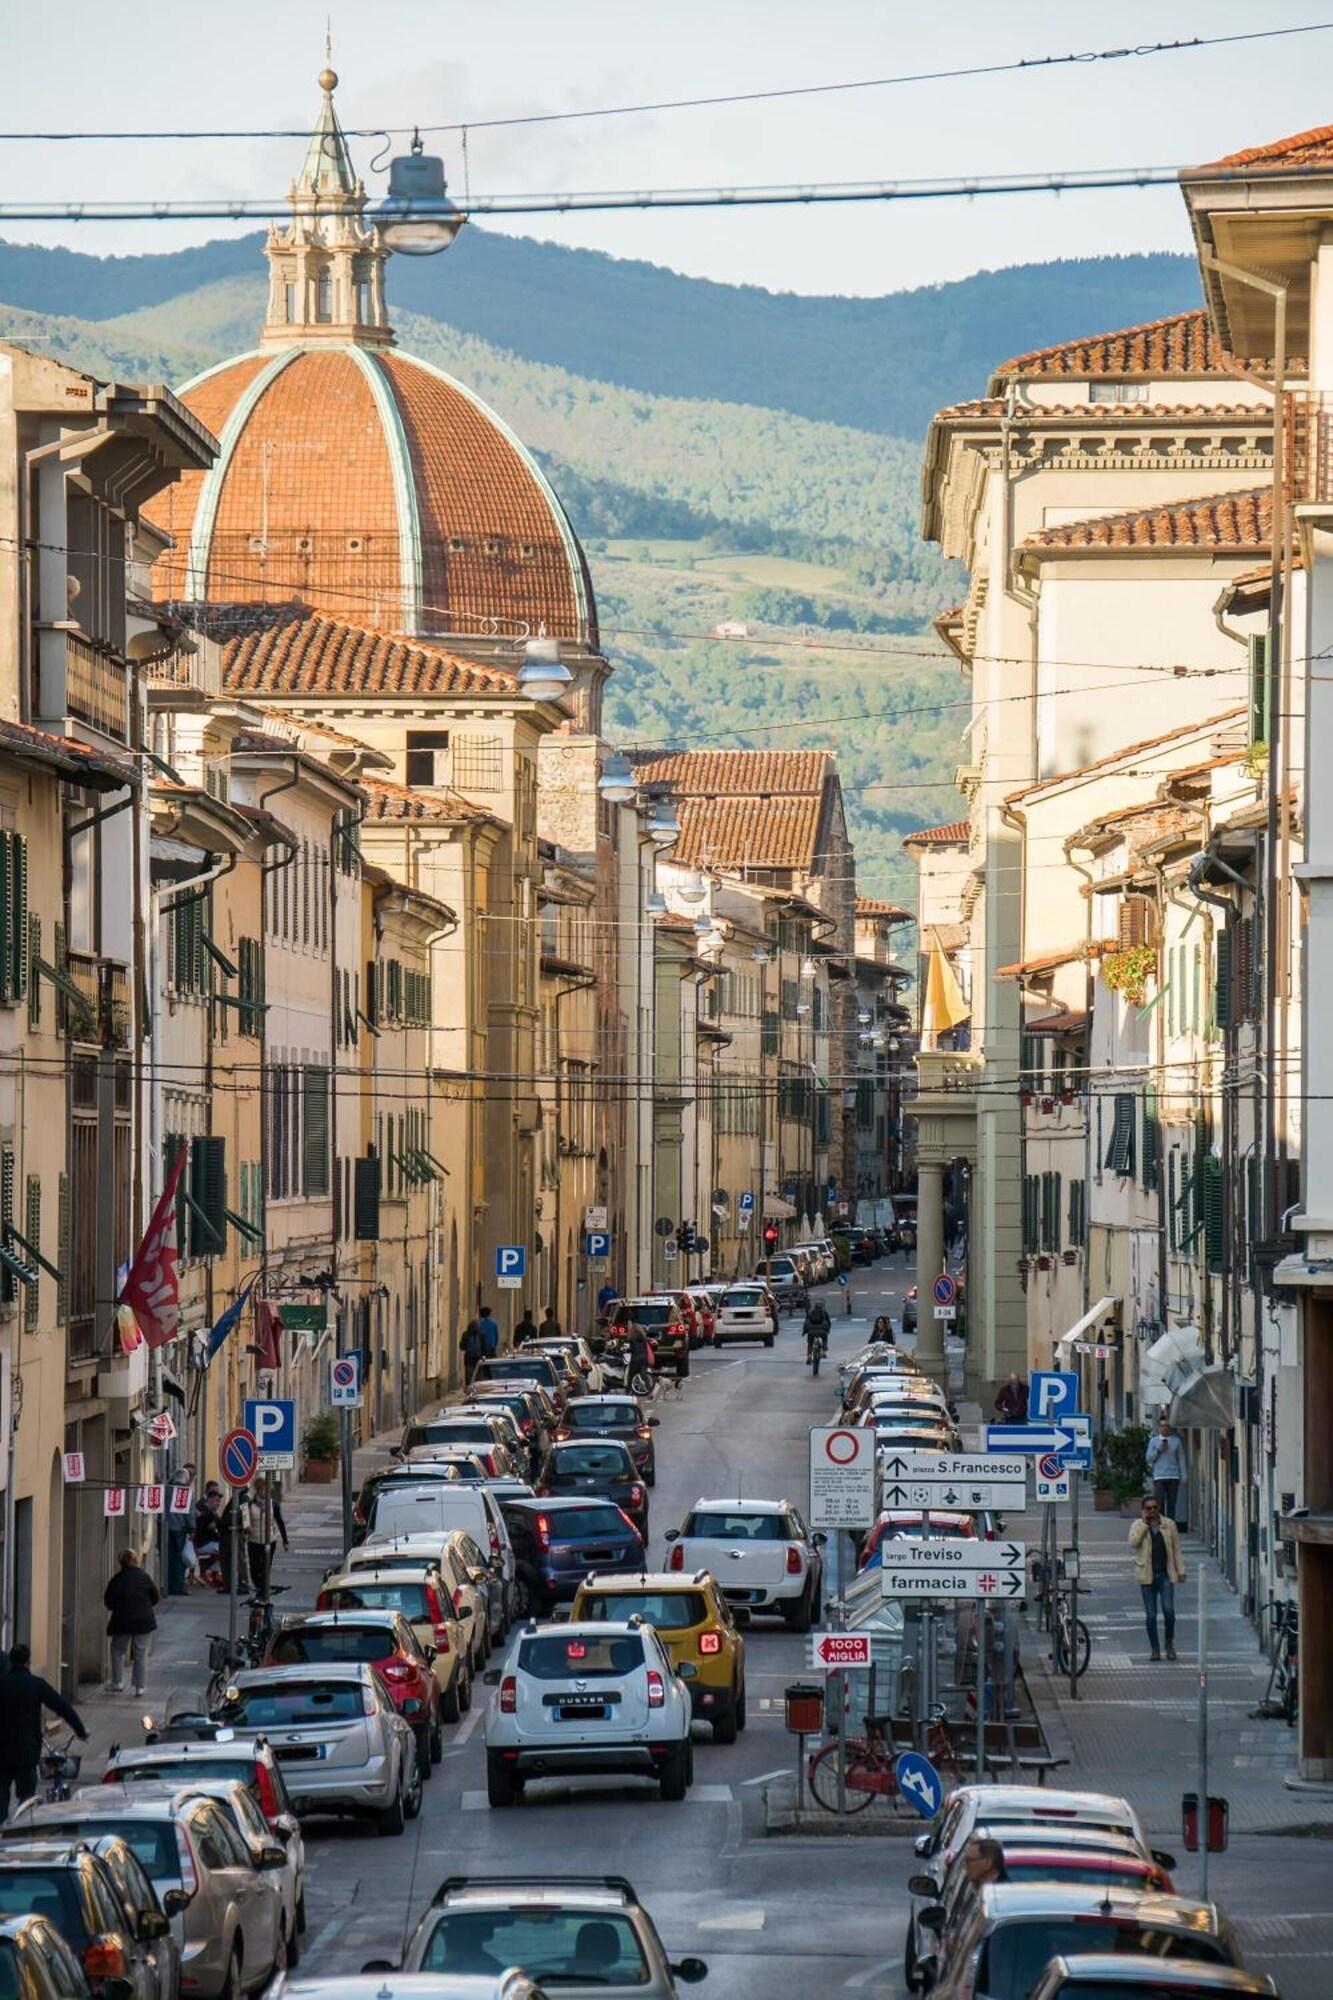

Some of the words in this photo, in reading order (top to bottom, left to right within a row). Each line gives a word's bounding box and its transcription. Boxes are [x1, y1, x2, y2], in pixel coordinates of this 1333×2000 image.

[743, 1194, 752, 1207] P
[591, 1236, 605, 1255] P
[501, 1249, 520, 1273] P
[1038, 1377, 1067, 1416] P
[255, 1404, 284, 1447] P
[938, 1461, 1022, 1474] S.Francesco
[909, 1547, 963, 1561] Treviso
[891, 1575, 967, 1590] farmacia
[830, 1639, 863, 1650] 1000
[828, 1651, 866, 1661] MIGLIA
